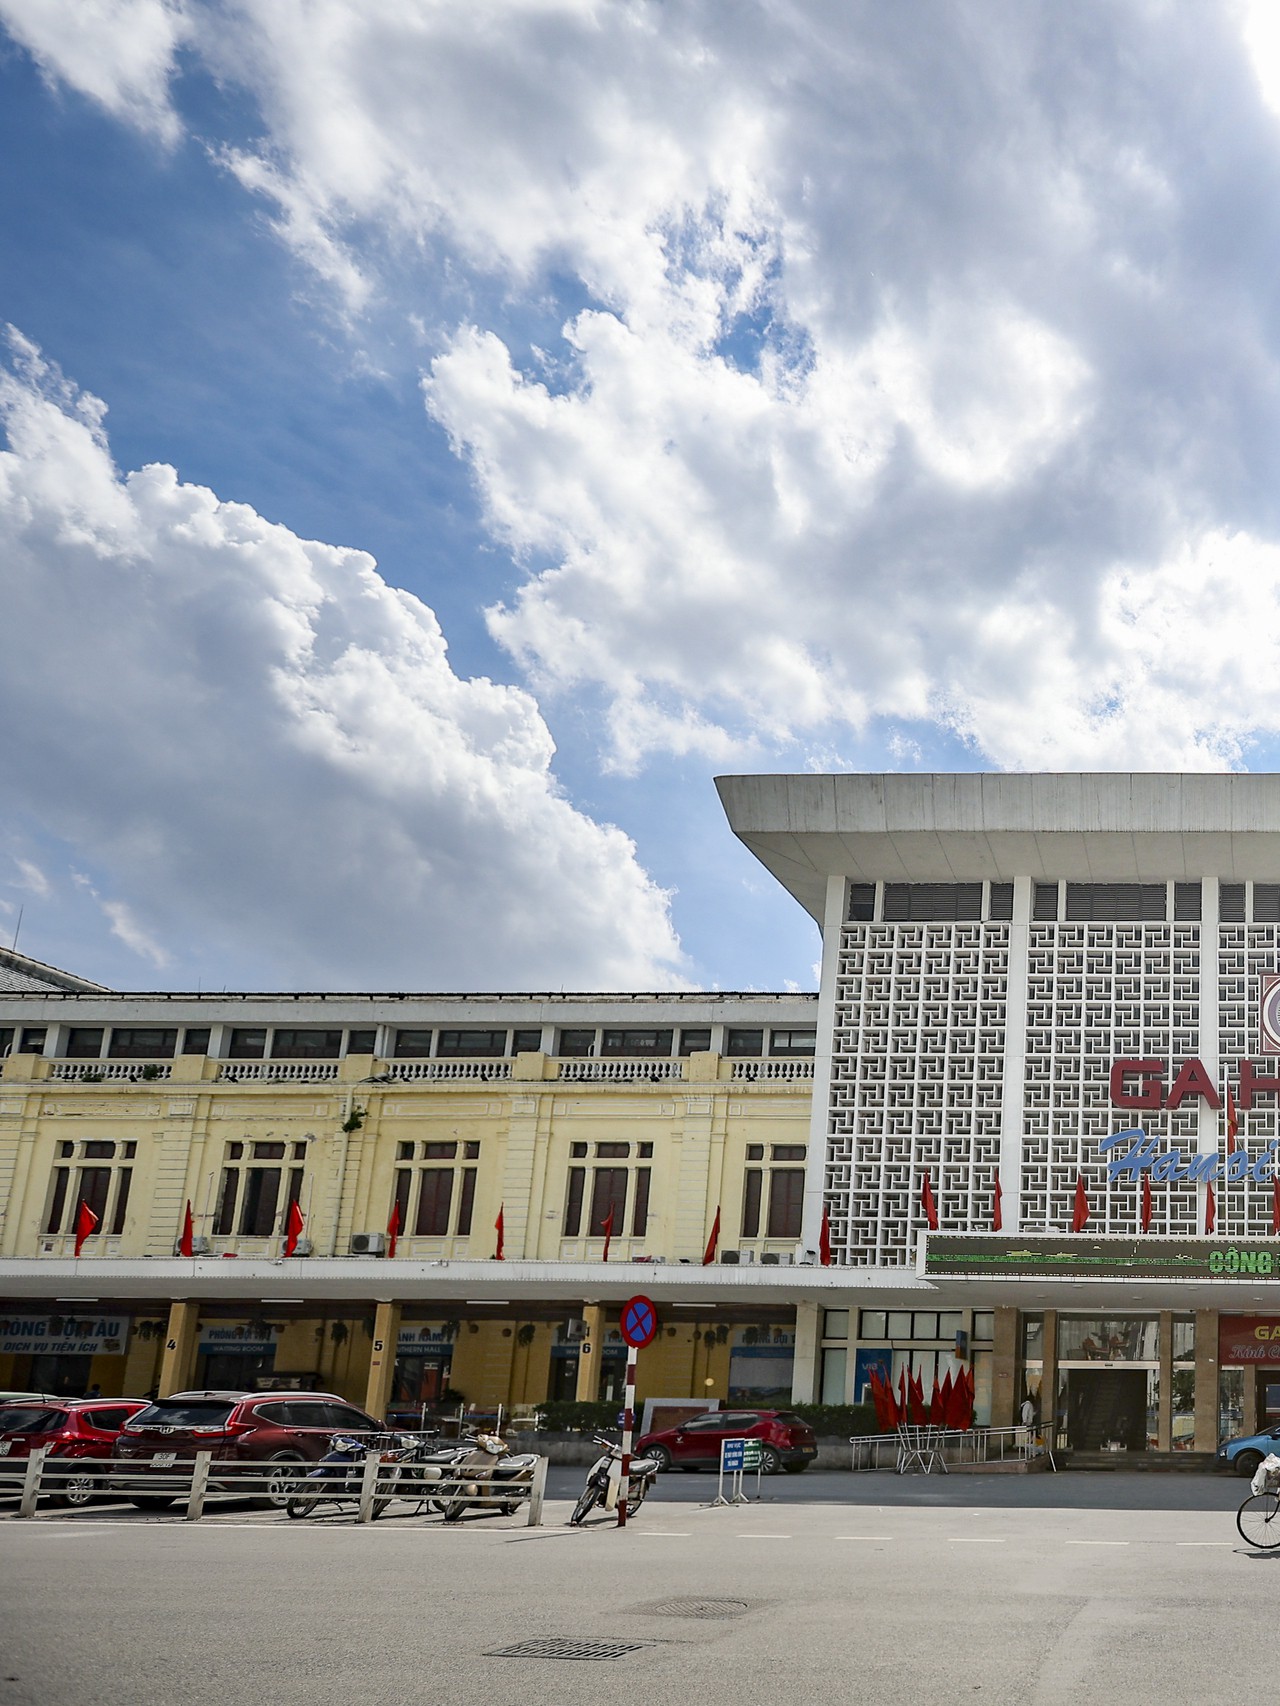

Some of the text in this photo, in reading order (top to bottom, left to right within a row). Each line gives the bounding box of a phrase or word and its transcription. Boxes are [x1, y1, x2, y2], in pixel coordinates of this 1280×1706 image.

[1109, 1058, 1222, 1111] GA
[1100, 1129, 1279, 1184] Hanoi
[1208, 1247, 1273, 1274] CÔNG
[33, 1342, 49, 1353] VỤ
[51, 1341, 76, 1353] TIỆN
[166, 1339, 176, 1350] 4
[373, 1340, 383, 1351] 5
[582, 1343, 591, 1354] 6
[1229, 1344, 1266, 1359] Kính
